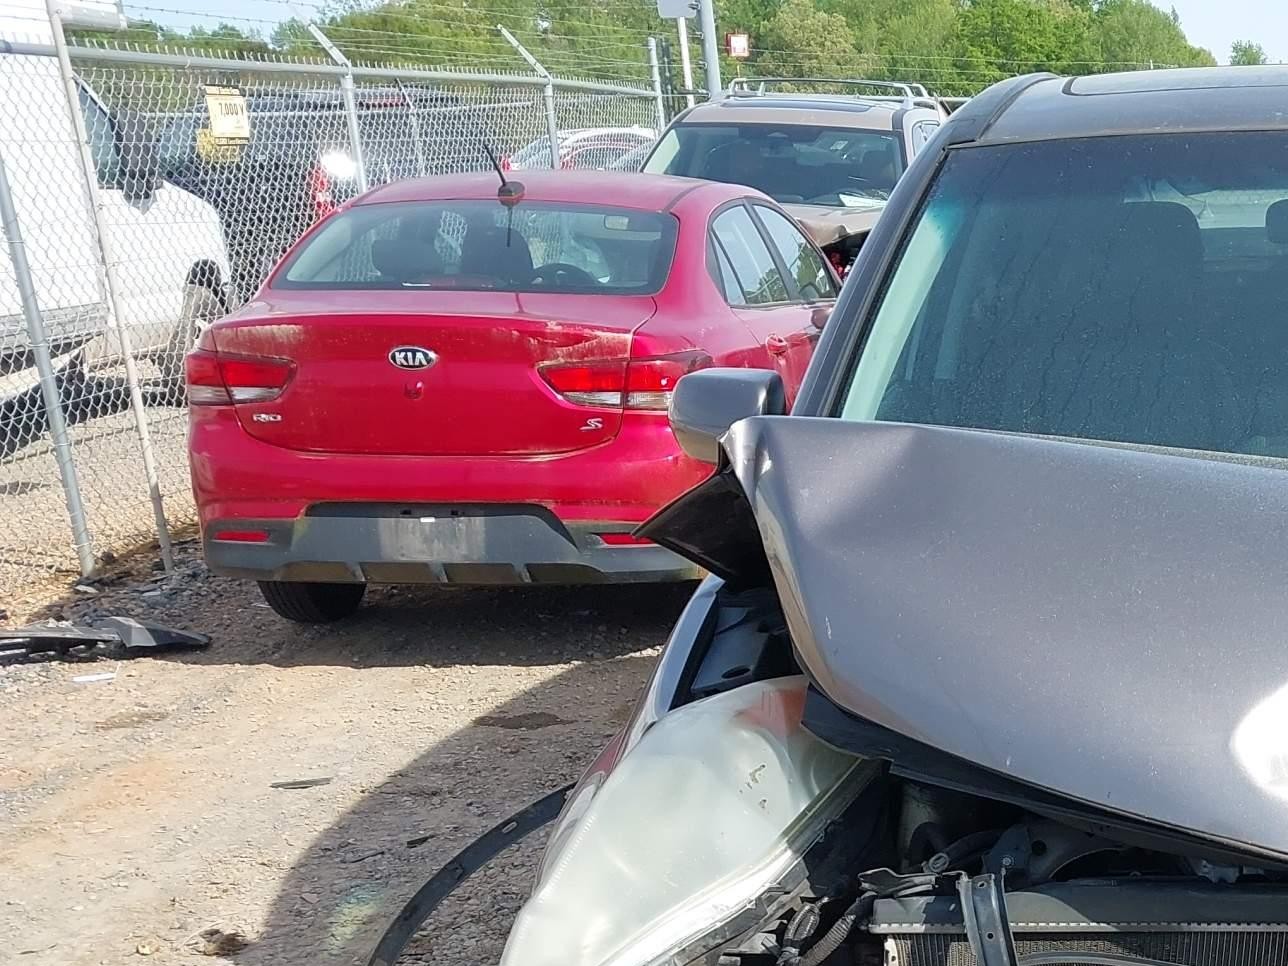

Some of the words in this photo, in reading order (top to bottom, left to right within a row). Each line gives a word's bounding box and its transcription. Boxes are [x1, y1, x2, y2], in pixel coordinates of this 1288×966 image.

[218, 102, 239, 117] 7,000
[395, 351, 428, 366] KIA
[252, 413, 283, 422] RIO
